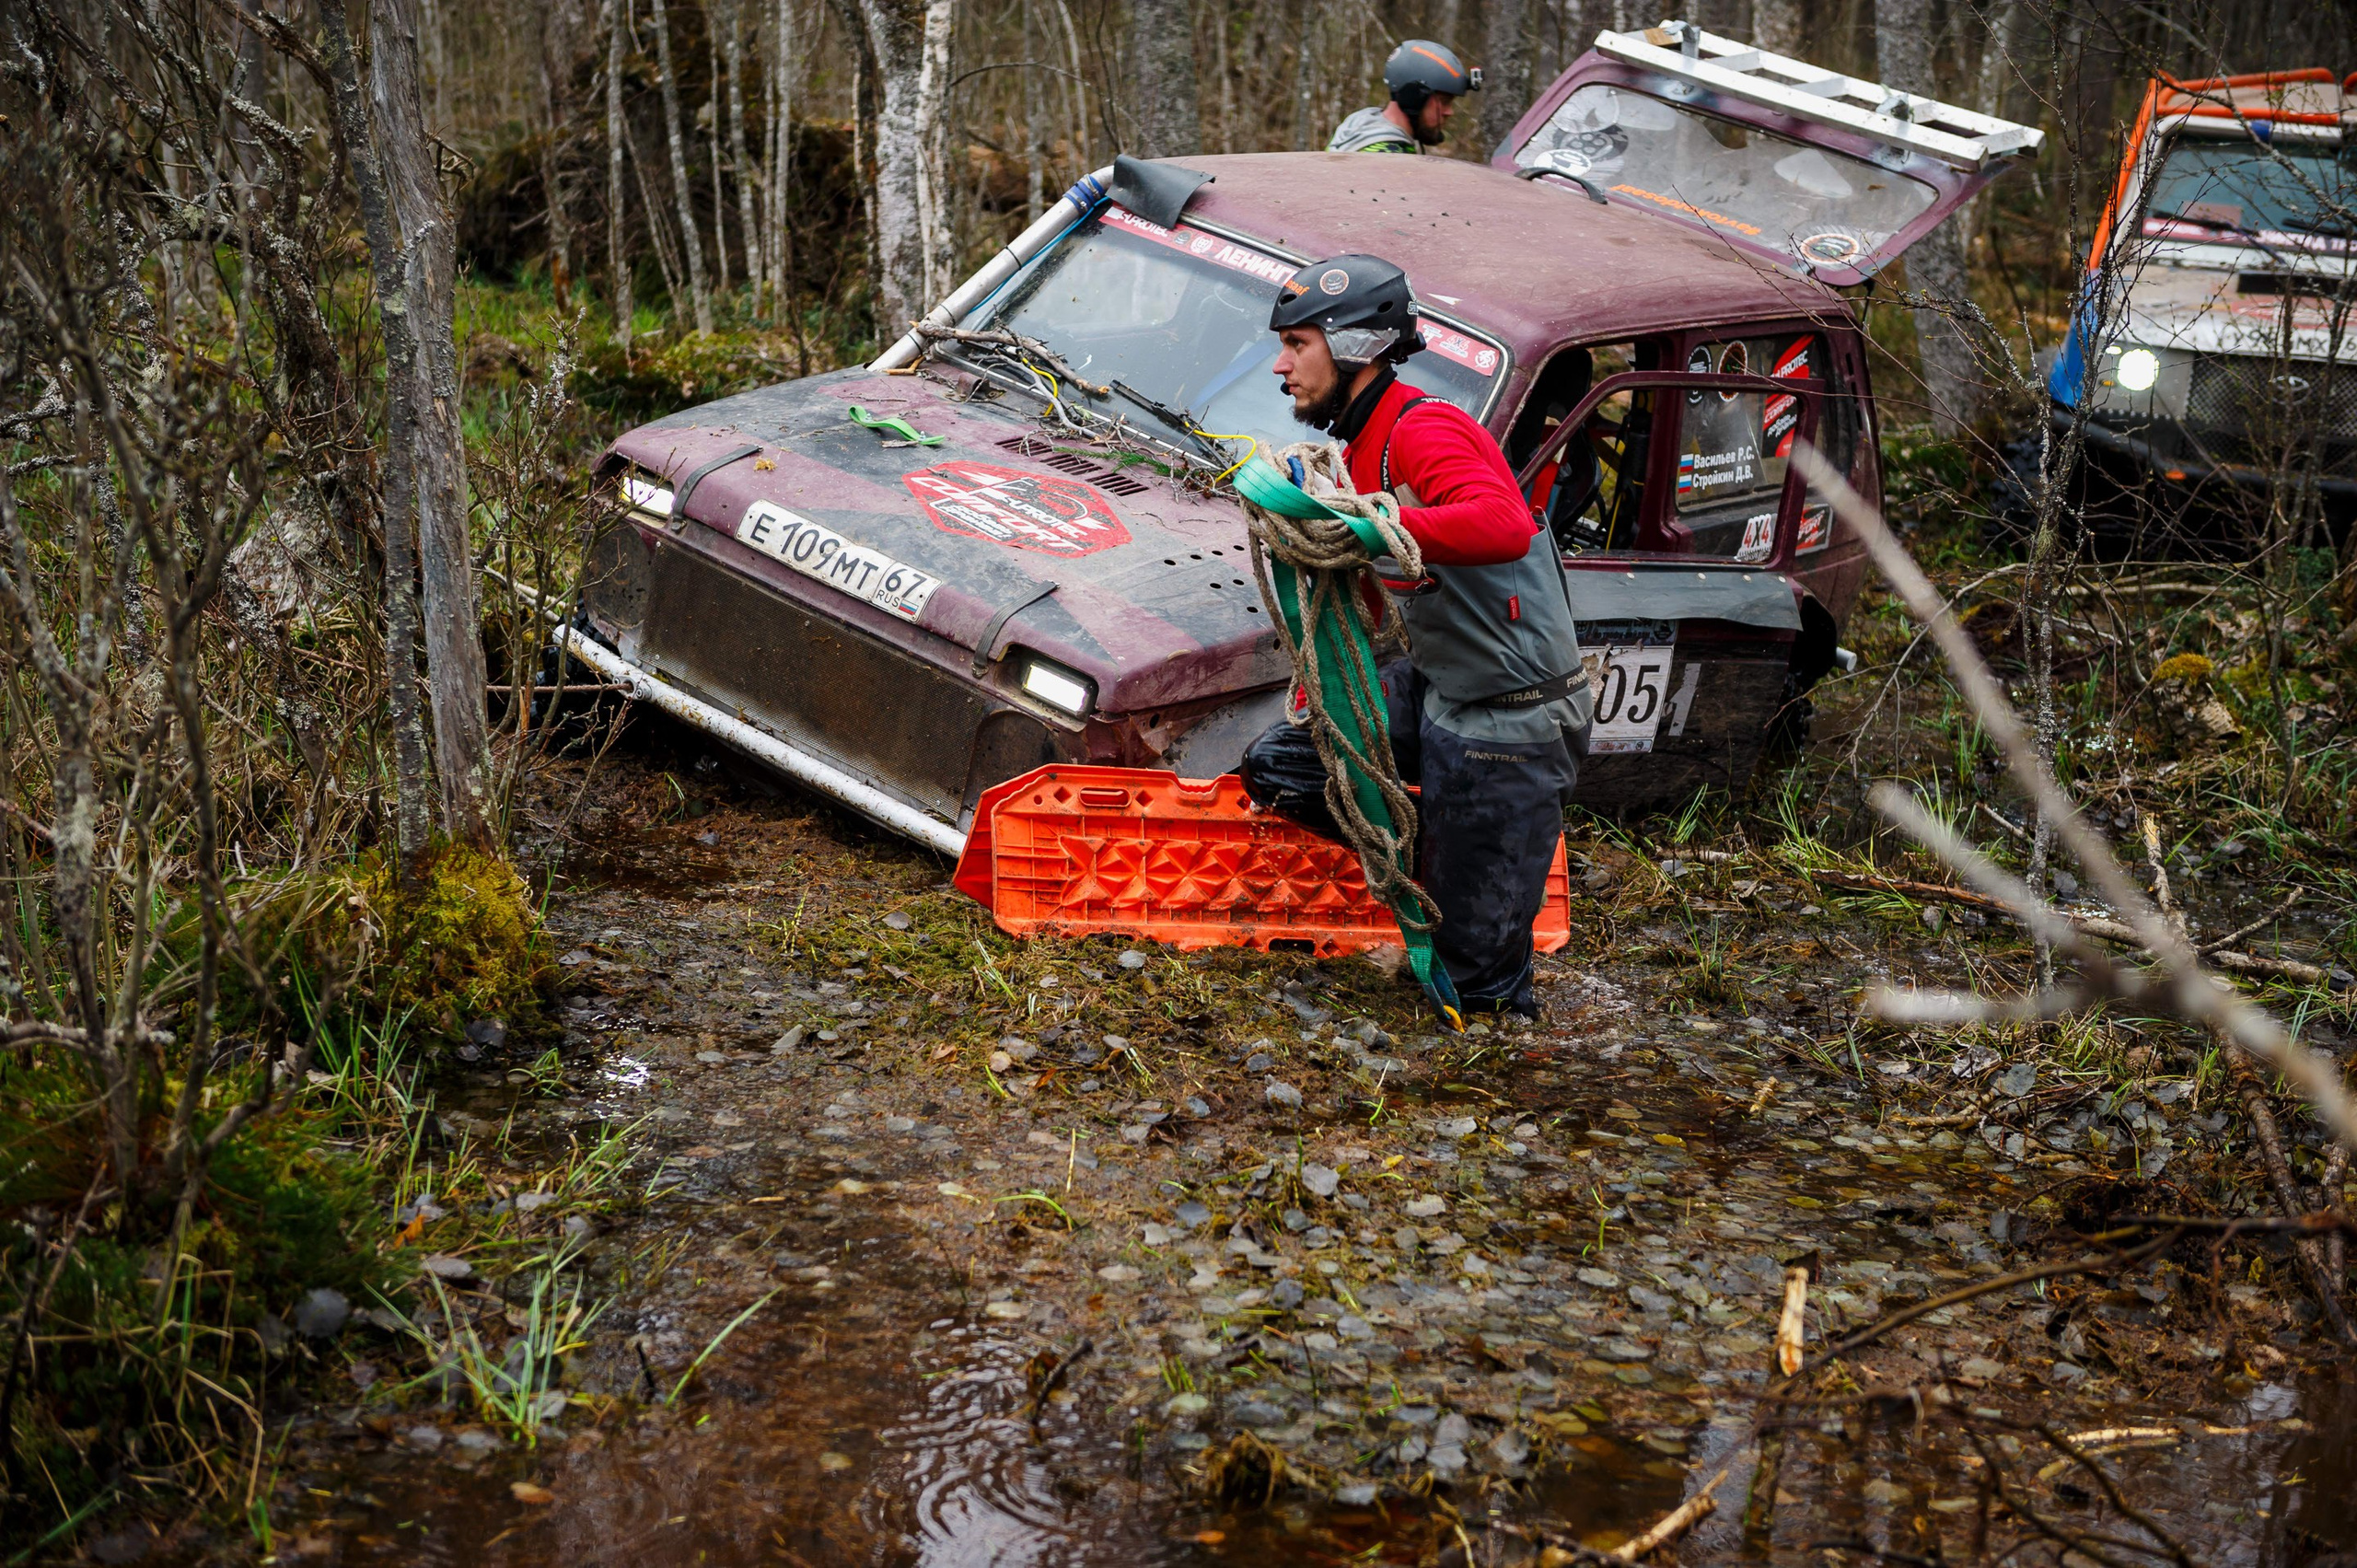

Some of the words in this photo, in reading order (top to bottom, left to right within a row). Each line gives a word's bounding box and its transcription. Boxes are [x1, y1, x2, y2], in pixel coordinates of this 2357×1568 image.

[1214, 245, 1298, 285] ЛЕНИНГ
[1693, 451, 1736, 469] Васильев
[1692, 470, 1734, 490] Стройкин
[910, 477, 1086, 552] COMFORT
[885, 567, 928, 599] 67
[876, 589, 900, 608] RUS
[1464, 749, 1528, 763] FINNTRAIL
